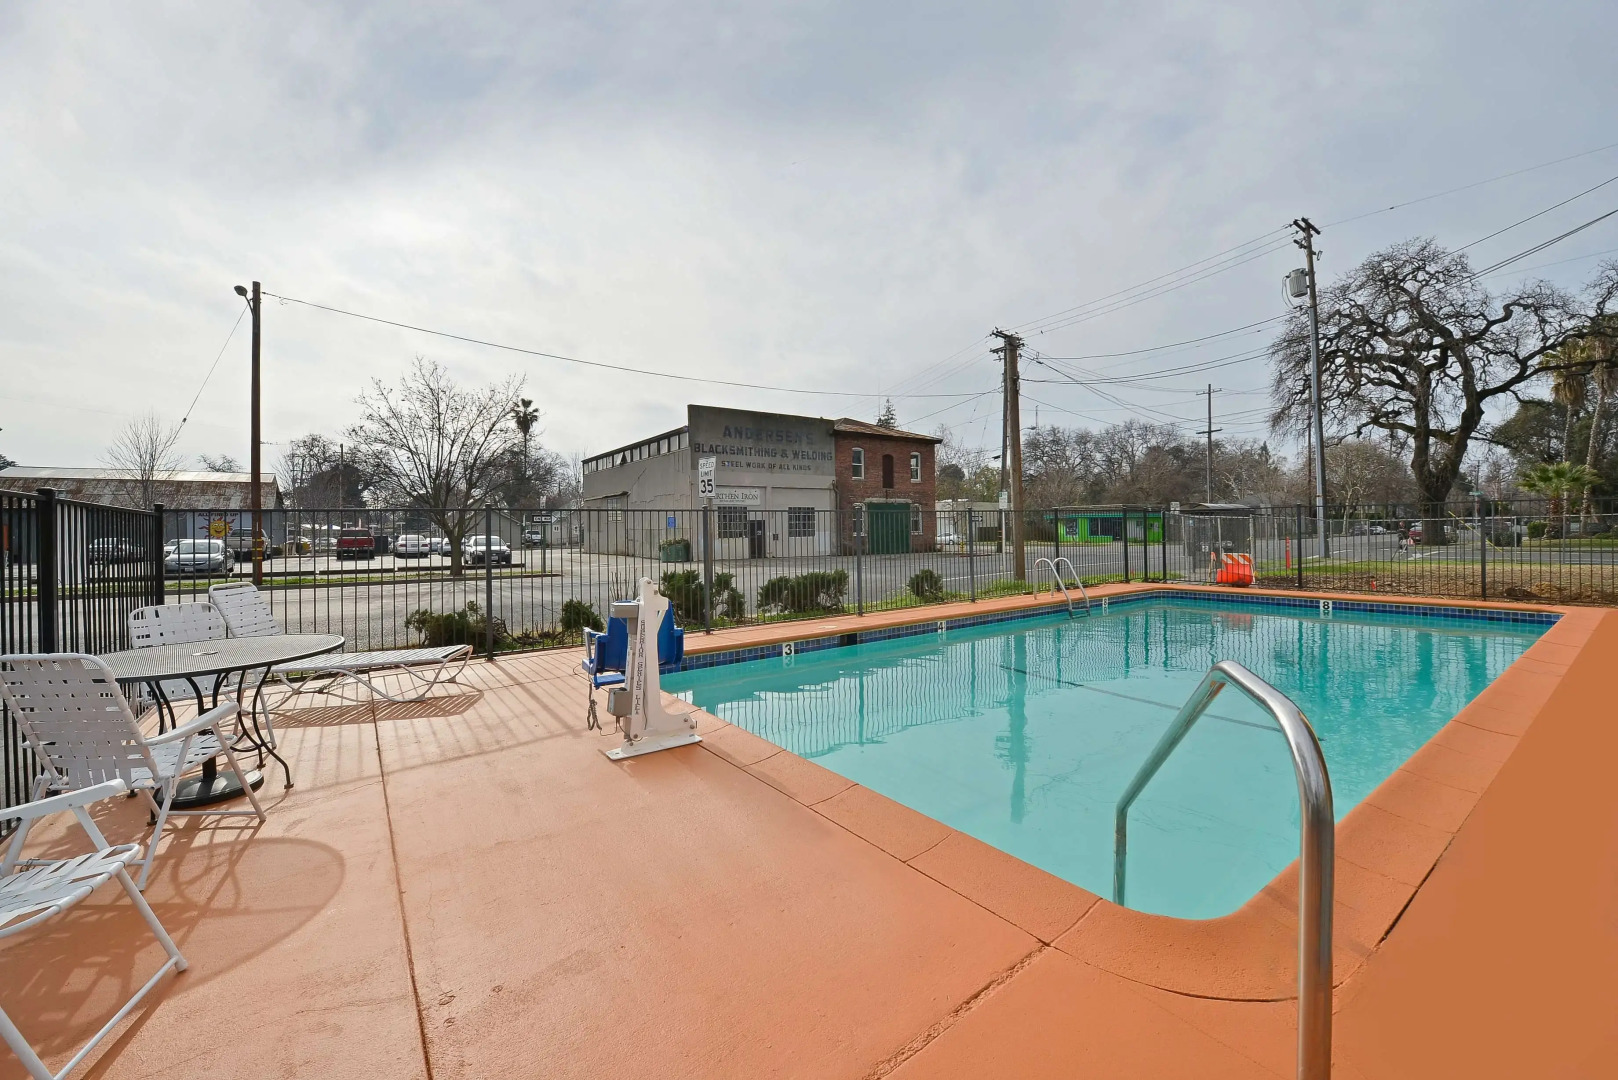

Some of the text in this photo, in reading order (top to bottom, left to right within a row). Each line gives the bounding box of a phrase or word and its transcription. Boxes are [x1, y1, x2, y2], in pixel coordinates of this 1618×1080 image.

[694, 443, 833, 461] BLACKSMITHING & WELDING
[700, 461, 714, 469] SPEED
[721, 460, 744, 468] STEEL
[701, 479, 713, 494] 35
[1322, 601, 1330, 610] 8
[938, 621, 944, 631] 4
[784, 644, 792, 656] 3
